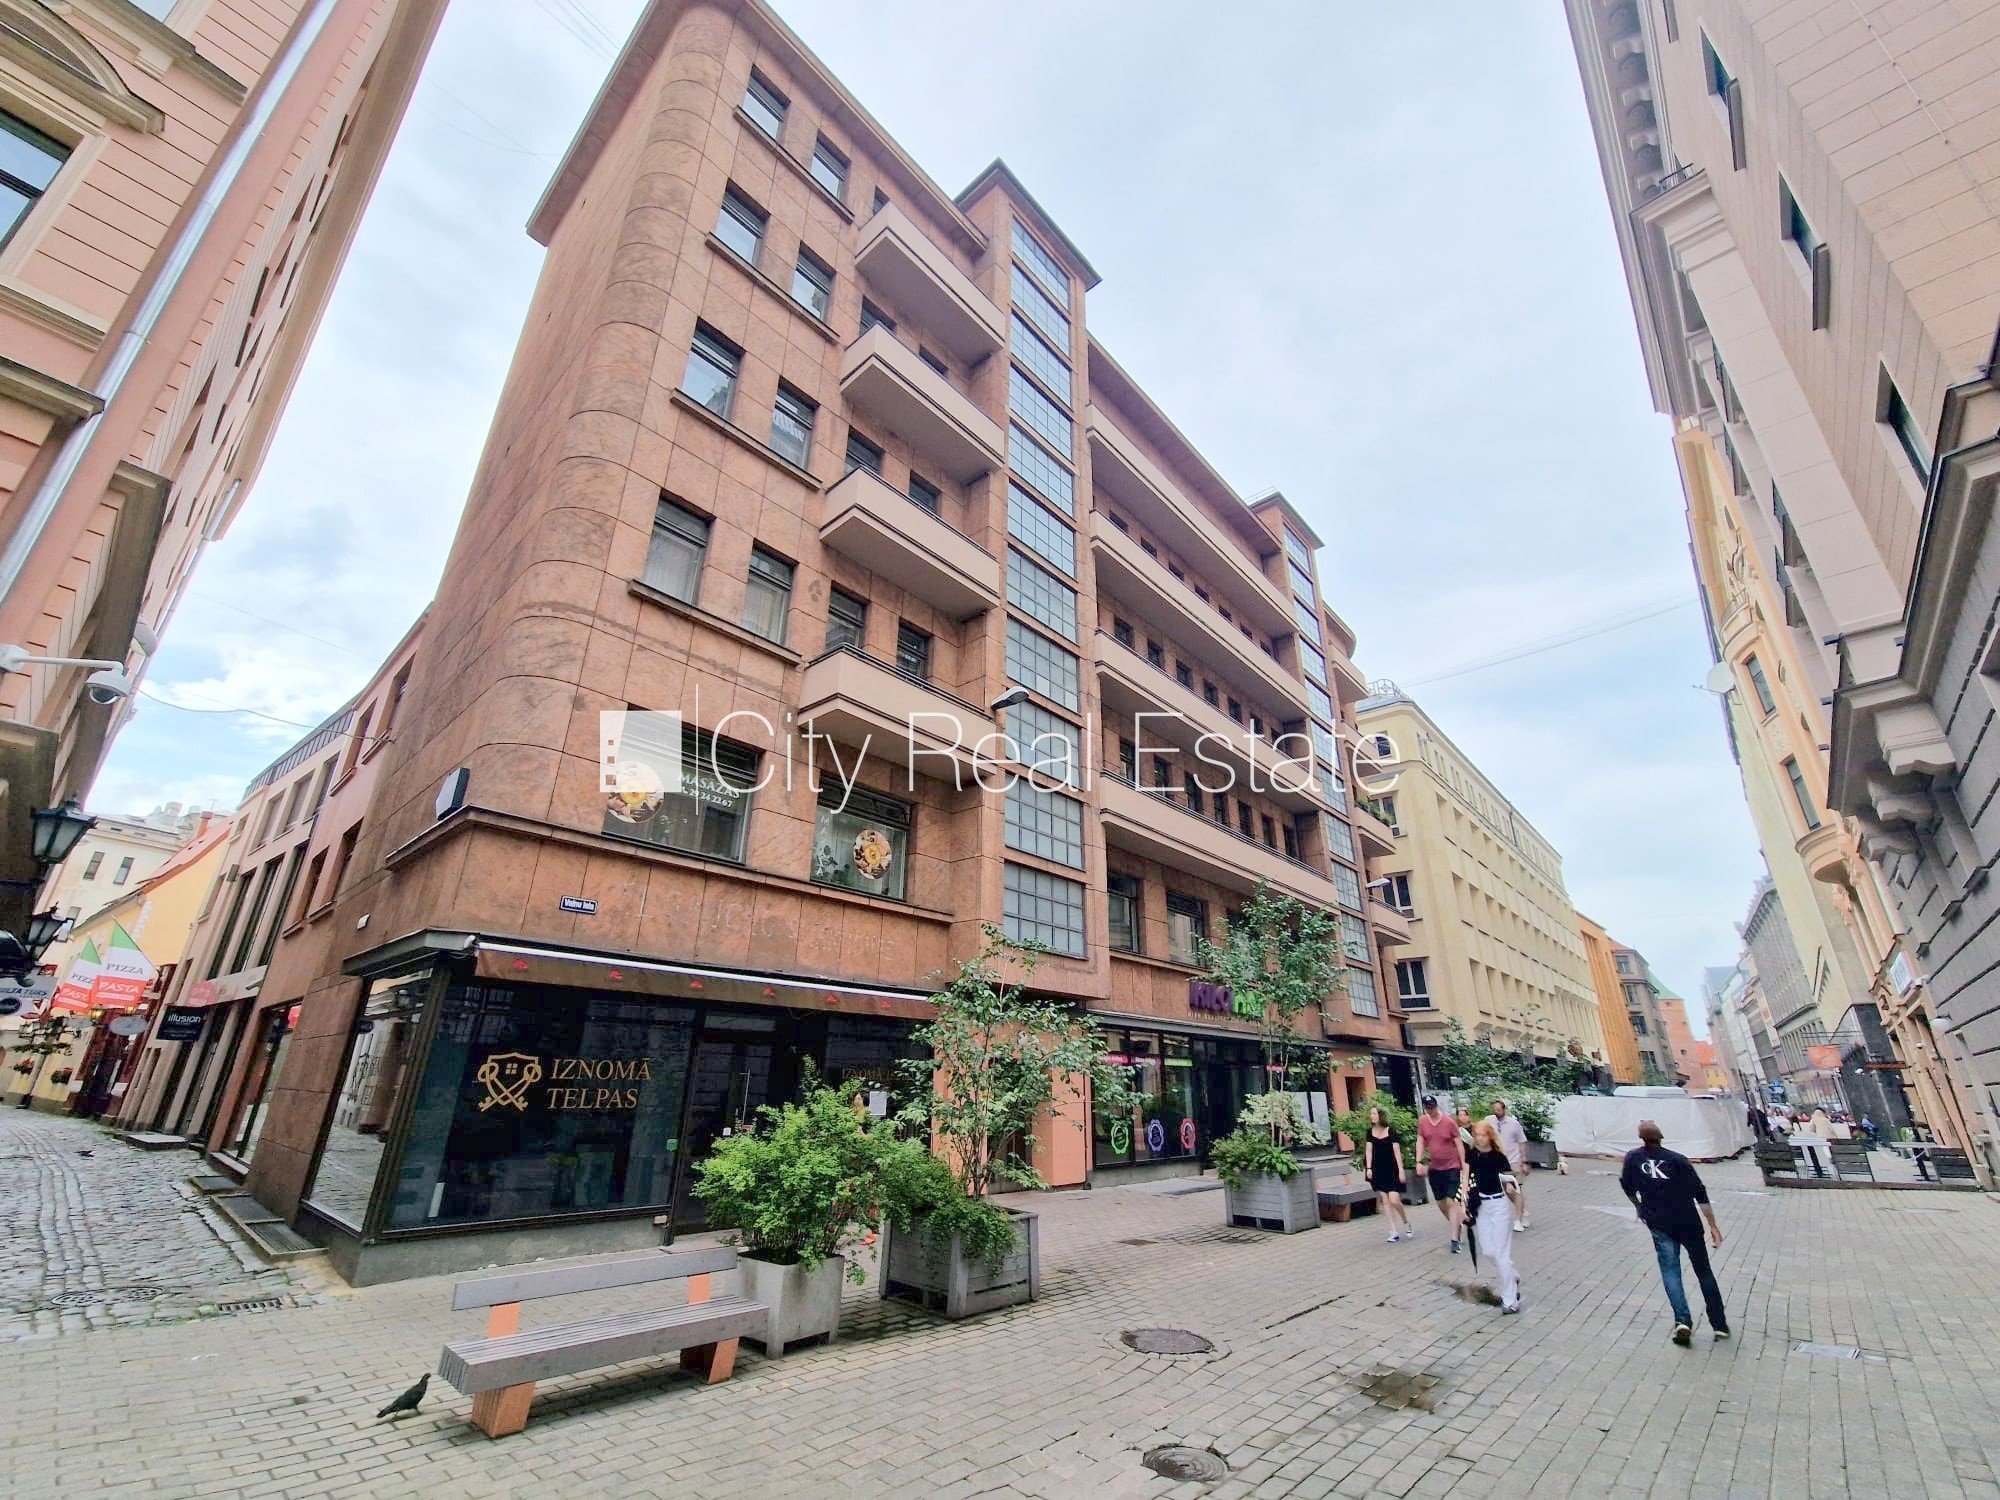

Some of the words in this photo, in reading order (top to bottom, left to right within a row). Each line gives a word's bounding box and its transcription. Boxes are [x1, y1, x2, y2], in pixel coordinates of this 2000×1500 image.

[106, 963, 144, 975] PIZZA
[71, 973, 94, 984] PIZZ
[98, 981, 140, 994] PASTA
[60, 988, 90, 1000] PAST
[551, 1057, 652, 1081] IZNOMĀ
[547, 1088, 639, 1110] TELPAS
